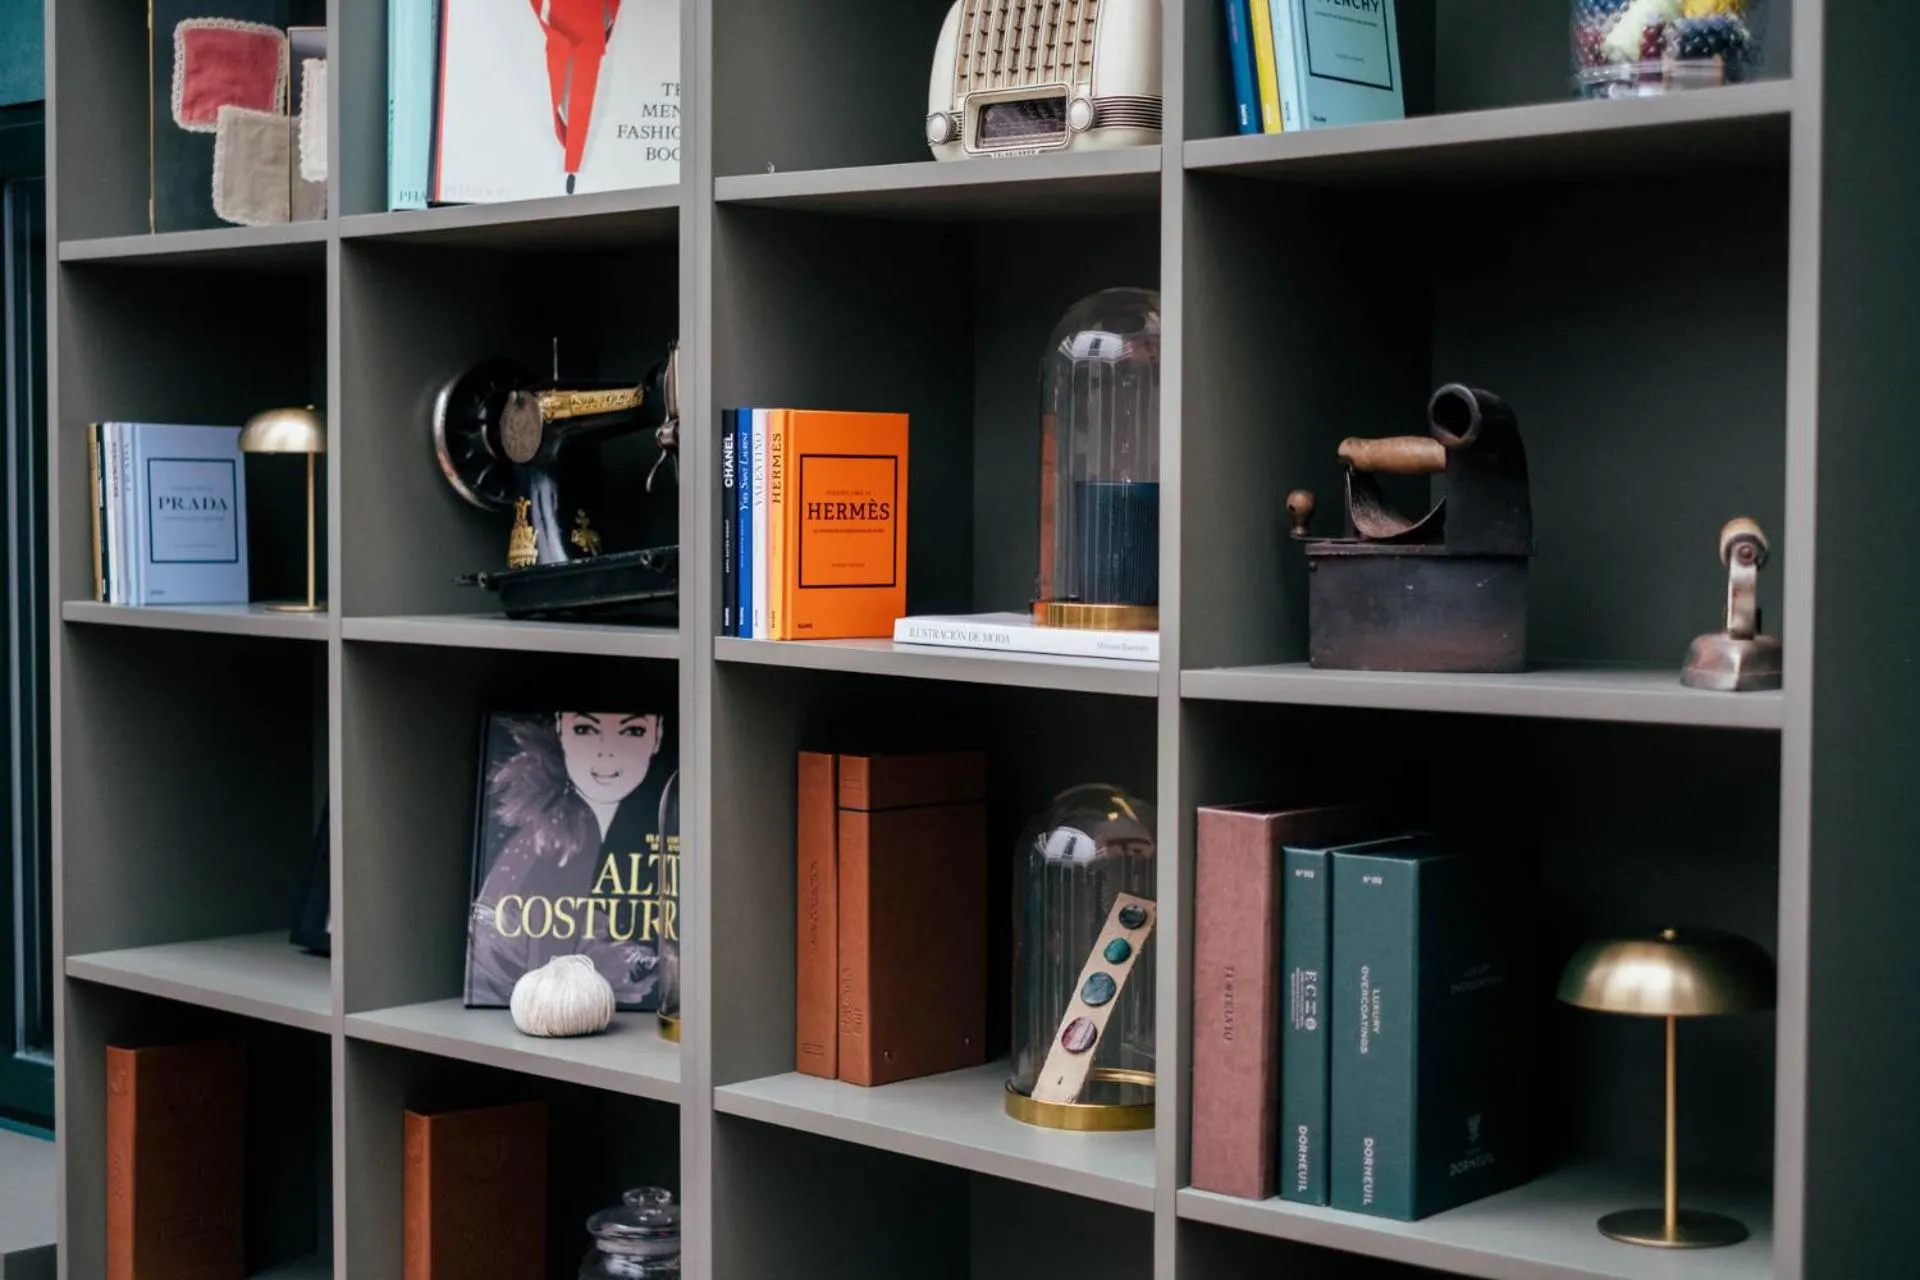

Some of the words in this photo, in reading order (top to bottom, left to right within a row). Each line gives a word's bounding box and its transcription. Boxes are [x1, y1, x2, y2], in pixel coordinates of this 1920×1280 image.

[724, 432, 734, 488] CHANEL
[753, 431, 764, 506] VALENTINO
[159, 496, 228, 511] PRADA
[807, 498, 891, 521] HERMÈS
[1360, 965, 1370, 1054] OVERCOATINGS
[1298, 1125, 1309, 1193] DORMEUIL
[1362, 1137, 1374, 1206] DORMEUIL
